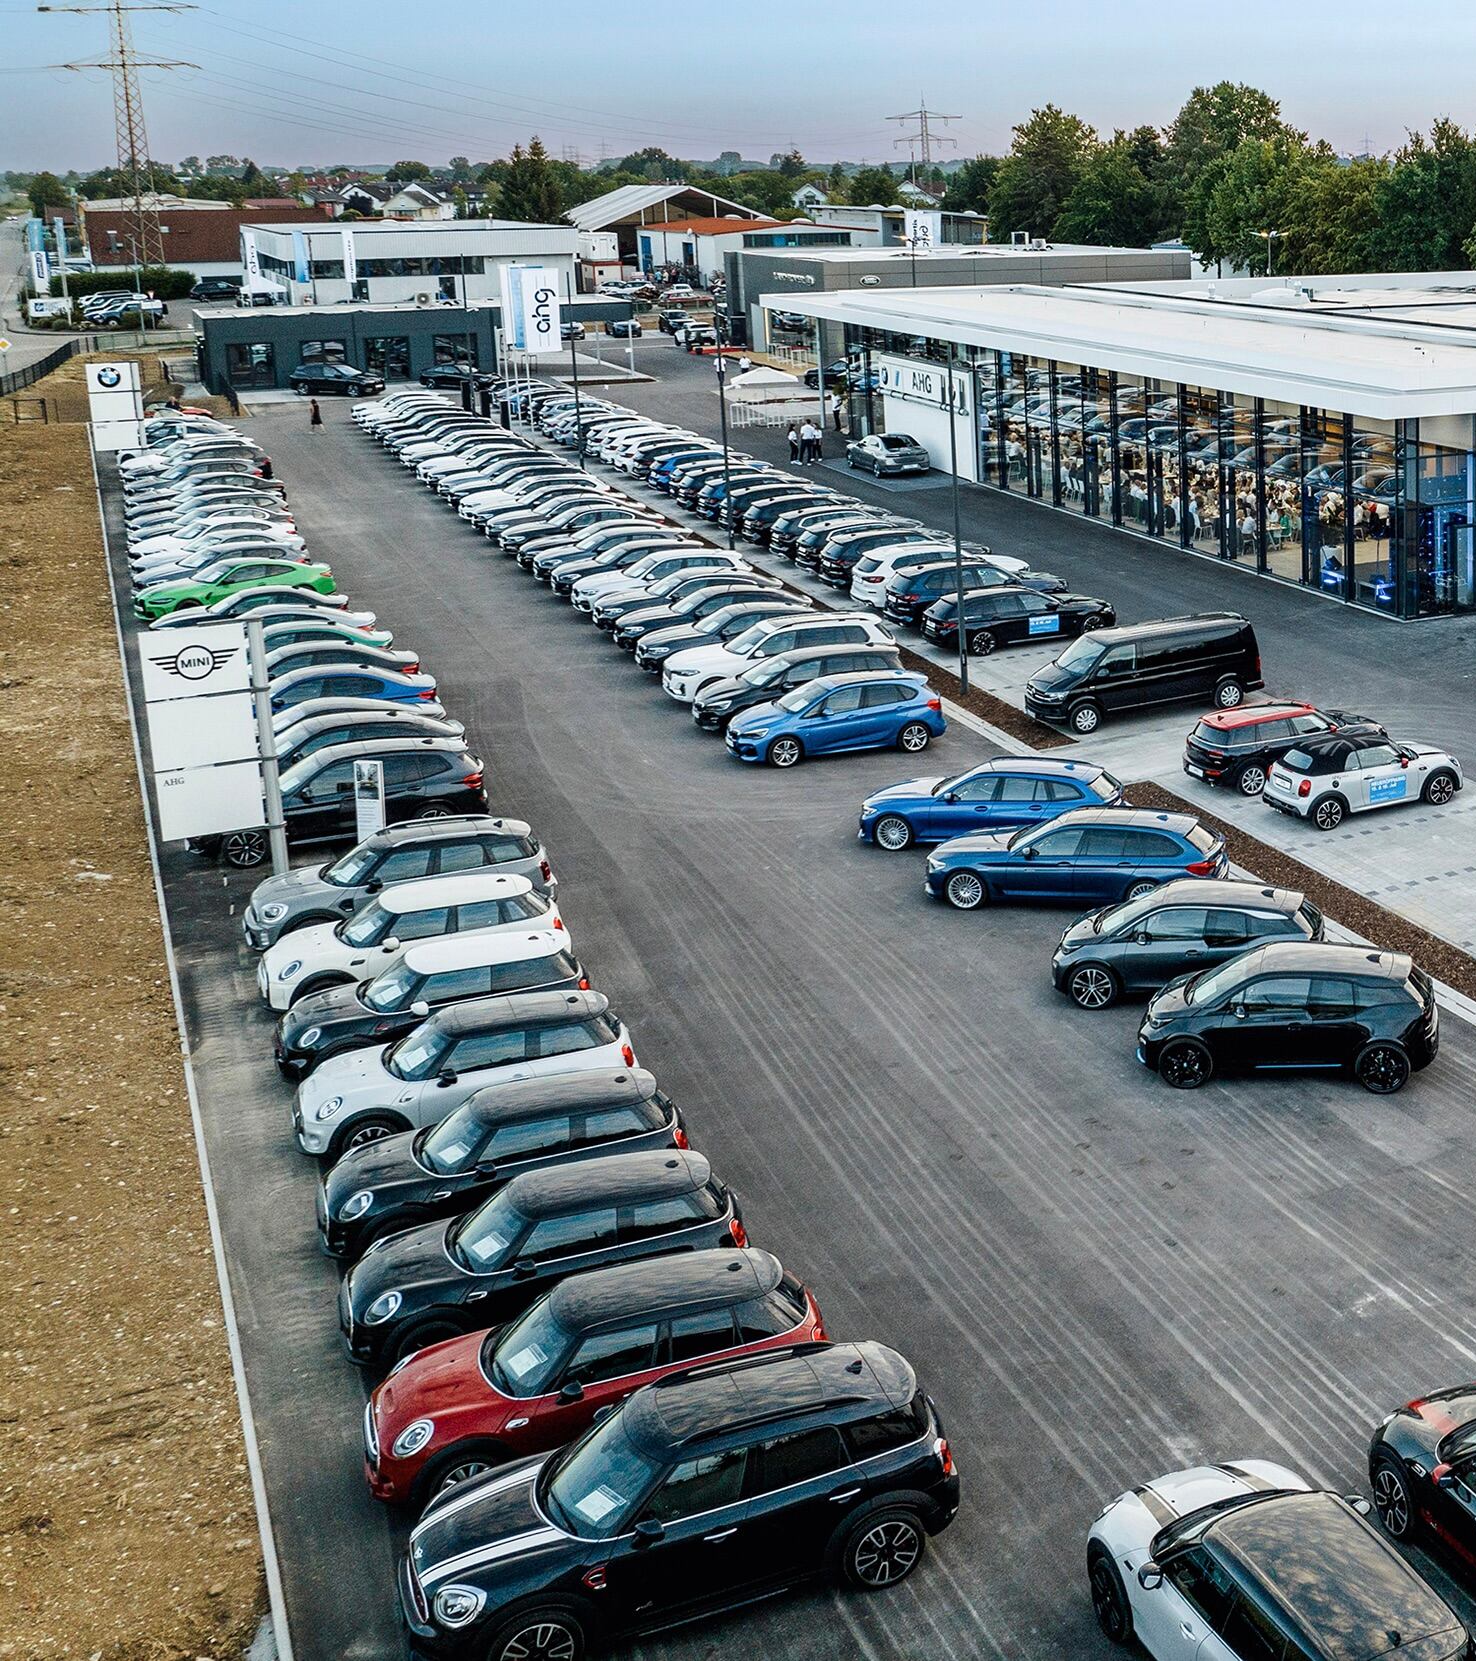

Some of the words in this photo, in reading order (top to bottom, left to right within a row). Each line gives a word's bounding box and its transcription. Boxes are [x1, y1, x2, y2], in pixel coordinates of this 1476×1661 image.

[531, 288, 556, 333] ahg
[912, 371, 932, 394] AHG
[181, 656, 210, 669] MINI
[163, 776, 185, 787] AHG
